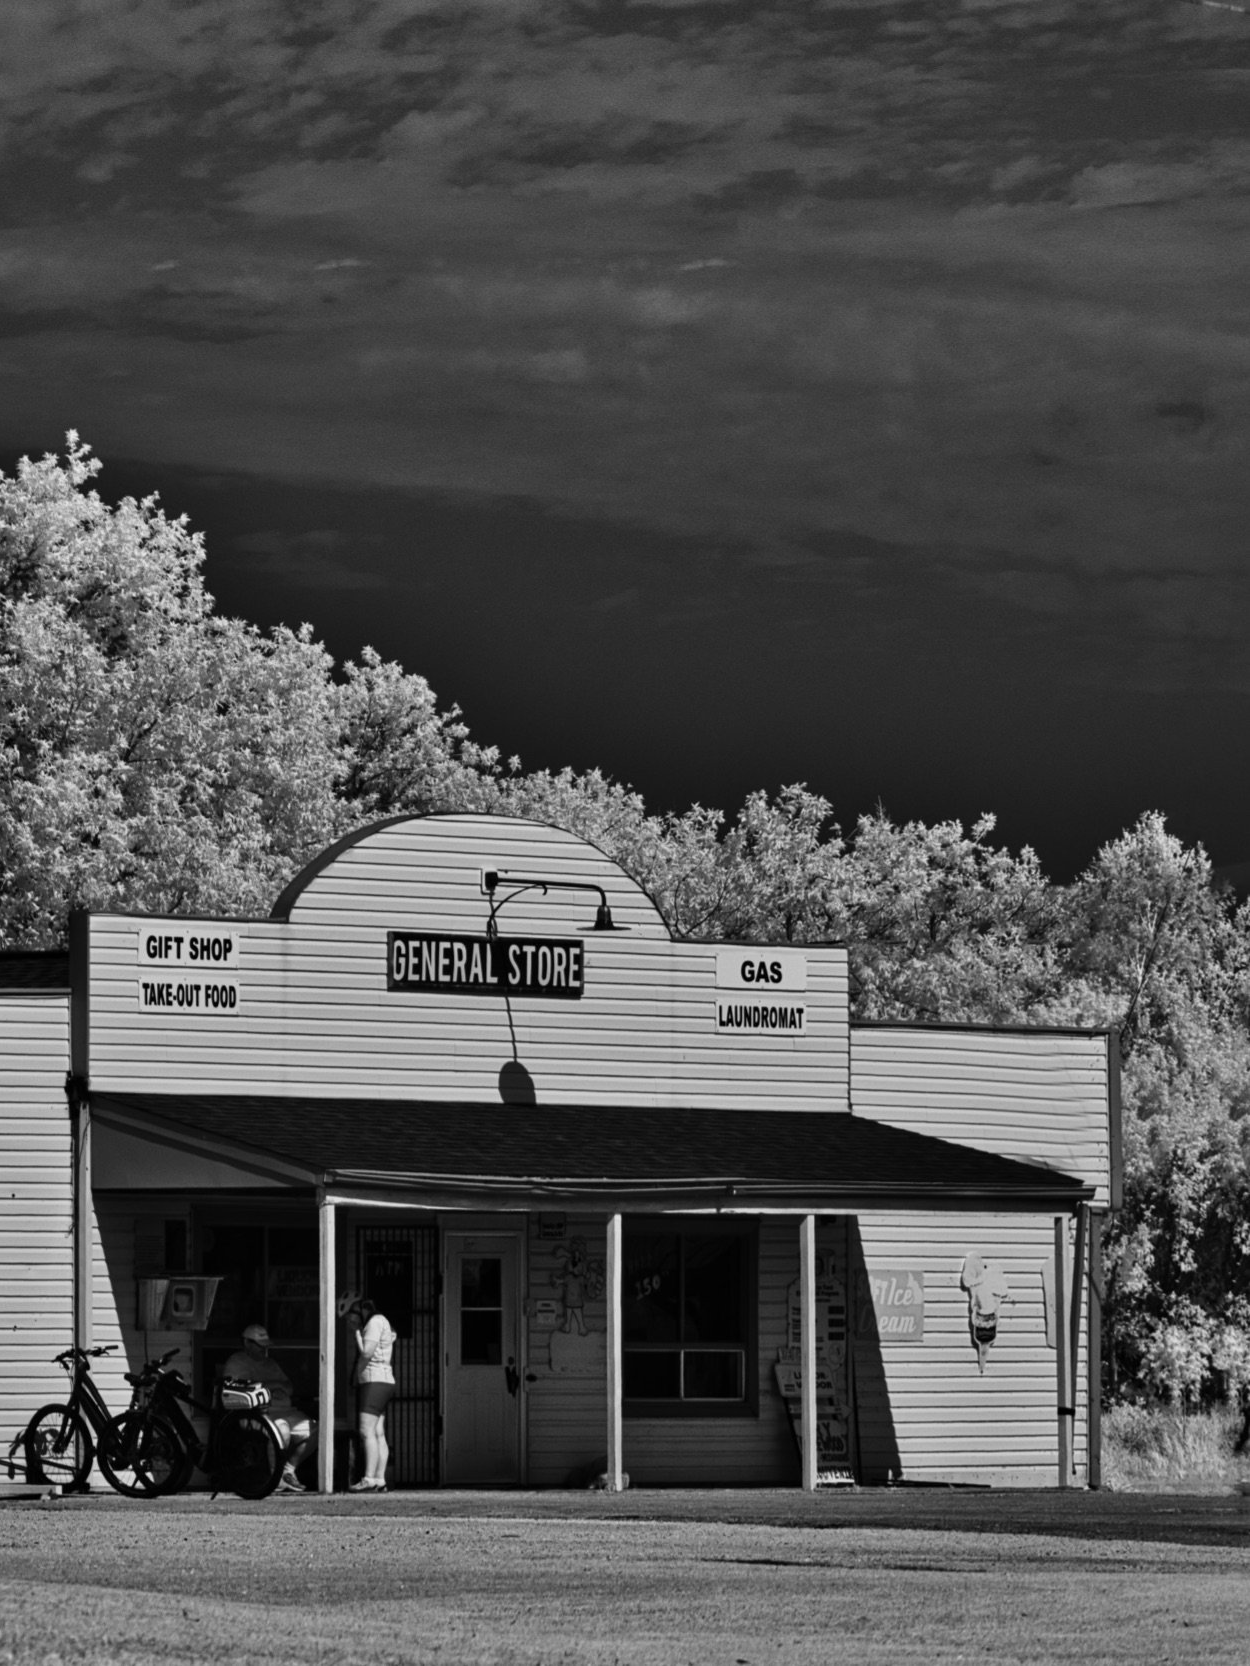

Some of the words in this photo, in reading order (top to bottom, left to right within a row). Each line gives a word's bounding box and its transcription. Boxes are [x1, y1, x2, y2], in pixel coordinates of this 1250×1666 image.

[146, 934, 185, 960] GIFT
[189, 937, 233, 962] SHOP
[392, 940, 498, 983] GENERAL
[508, 945, 581, 988] STORE
[741, 960, 783, 984] GAS
[143, 982, 201, 1007] TAKE-OUT
[205, 984, 236, 1008] FOOD
[718, 1005, 804, 1030] LAUNDROMAT
[886, 1277, 913, 1305] Ice
